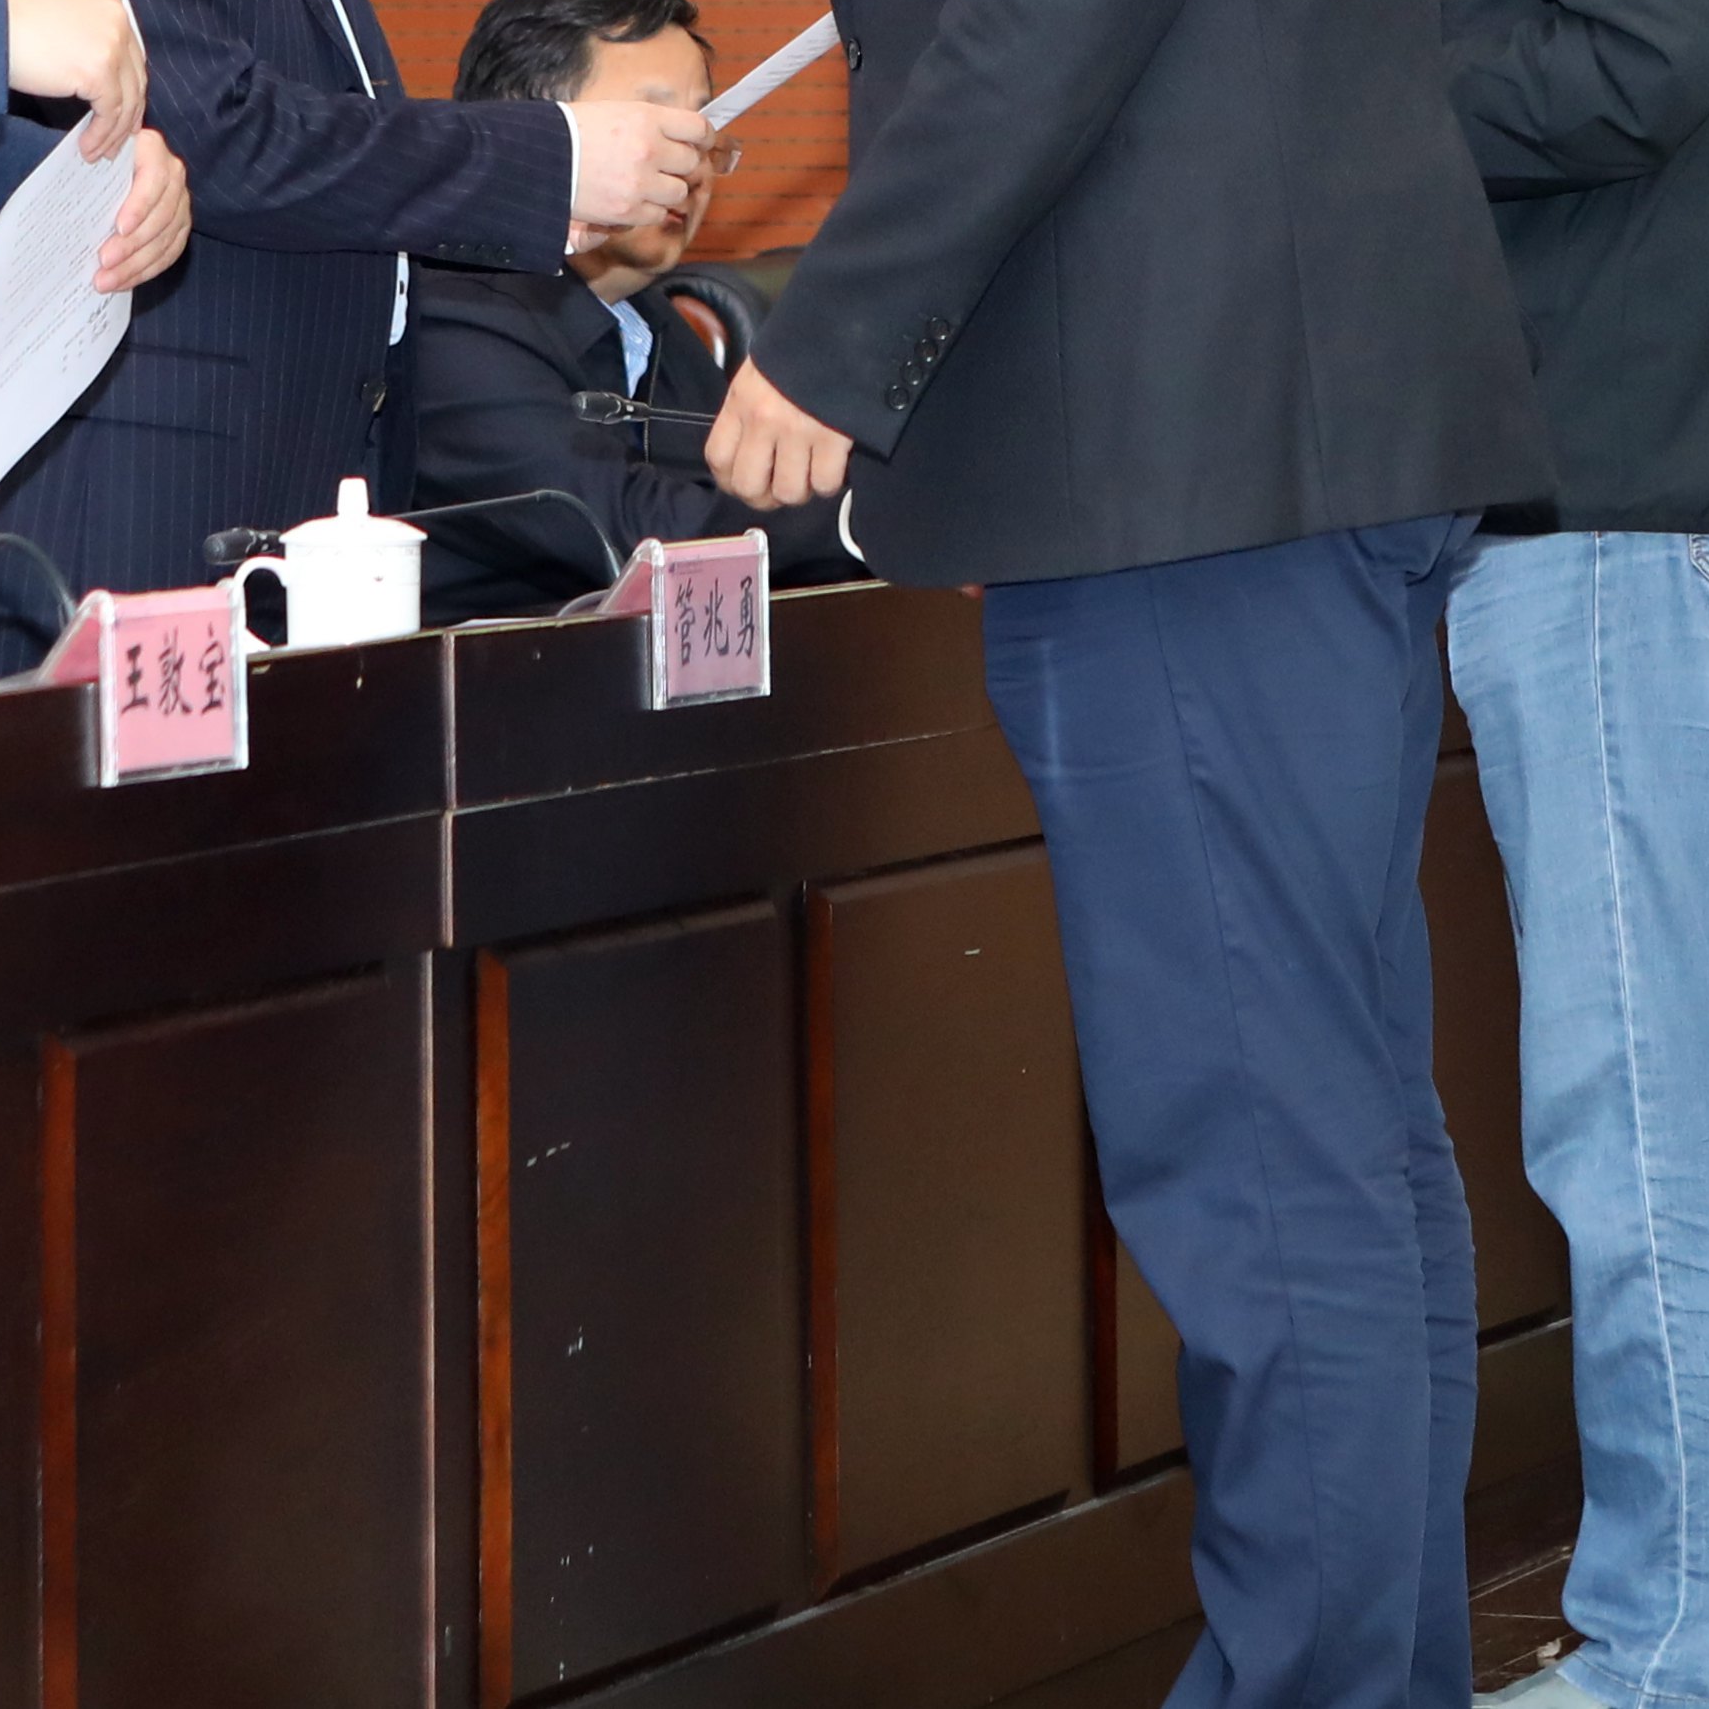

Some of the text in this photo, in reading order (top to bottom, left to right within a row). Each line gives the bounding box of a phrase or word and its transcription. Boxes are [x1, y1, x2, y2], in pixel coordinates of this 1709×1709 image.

[674, 575, 755, 667] 管兆勇
[121, 622, 225, 715] 王敦宝
